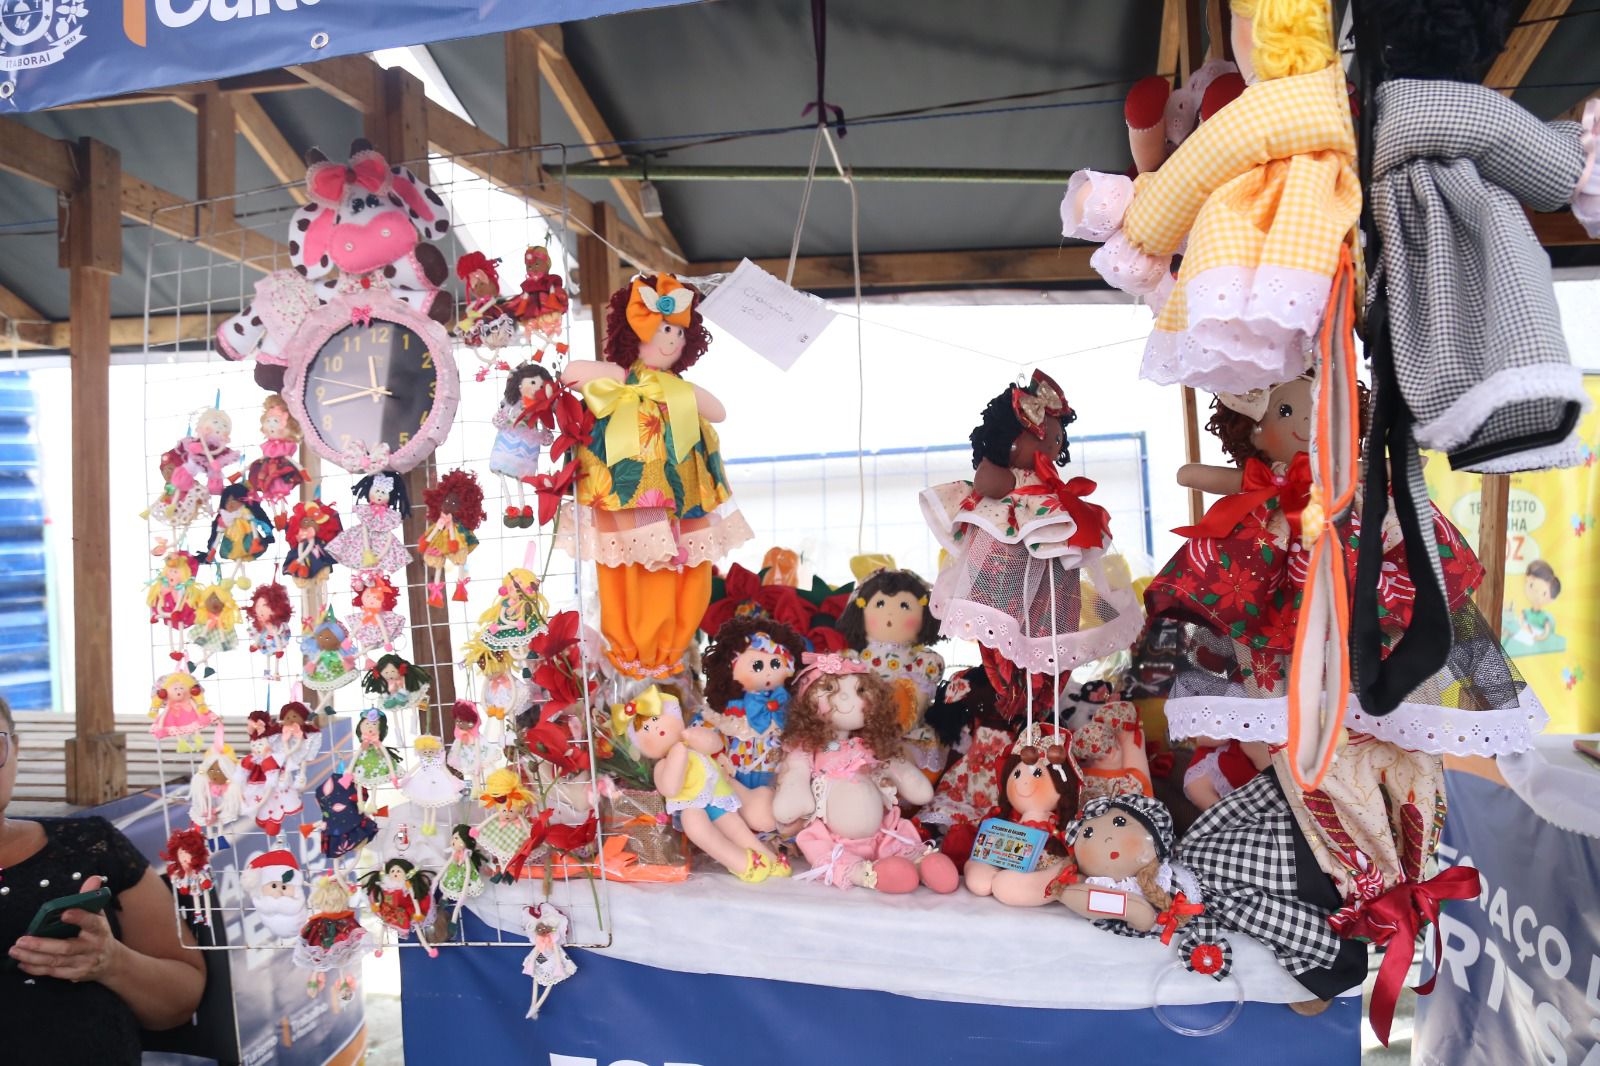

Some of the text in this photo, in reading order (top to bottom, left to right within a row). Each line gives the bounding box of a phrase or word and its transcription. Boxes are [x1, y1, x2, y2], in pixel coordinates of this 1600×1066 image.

[343, 336, 361, 352] 11
[370, 328, 389, 344] 12
[403, 335, 409, 350] 1
[323, 356, 343, 373] 10
[421, 352, 432, 369] 2
[316, 387, 326, 401] 9
[322, 415, 332, 431] 8
[399, 433, 409, 447] 5
